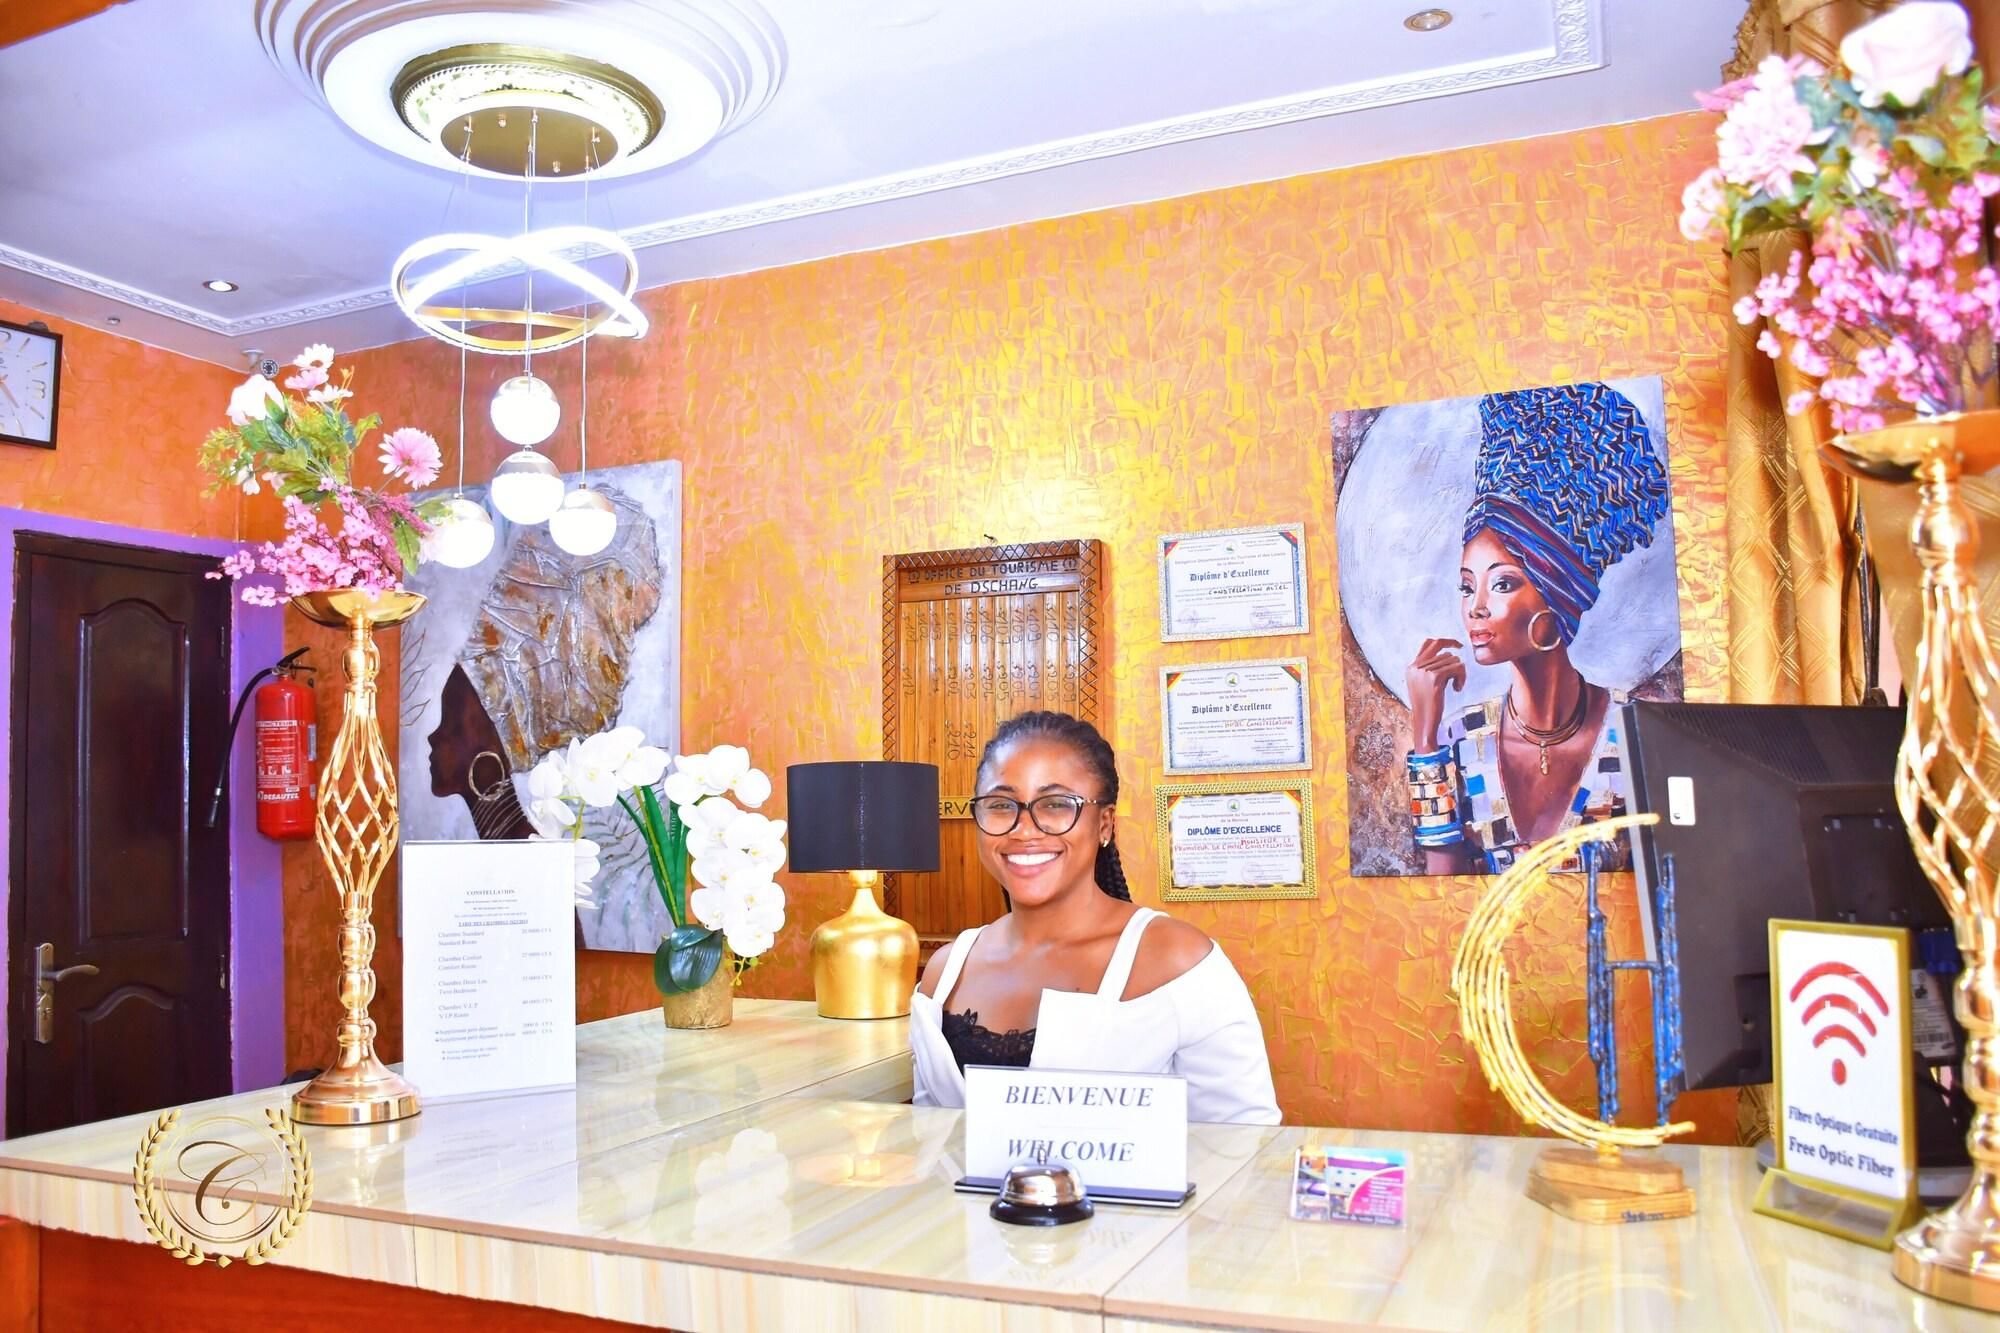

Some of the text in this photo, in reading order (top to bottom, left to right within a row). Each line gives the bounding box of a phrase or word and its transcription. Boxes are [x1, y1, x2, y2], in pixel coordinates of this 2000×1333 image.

[969, 566, 985, 577] DU
[1190, 569, 1270, 582] Diplôme d'Excellence
[944, 578, 1038, 596] DE DSCHANG
[1192, 703, 1272, 714] Diplôme d'Excellence
[1187, 825, 1282, 836] DIPLÔME D'EXCELLENCE
[1005, 1085, 1154, 1107] BIENVENUE
[1789, 1106, 1898, 1145] Fibre Optique Gratuite
[1008, 1139, 1135, 1162] WELCOME
[1789, 1136, 1895, 1178] Free Optic Fiber
